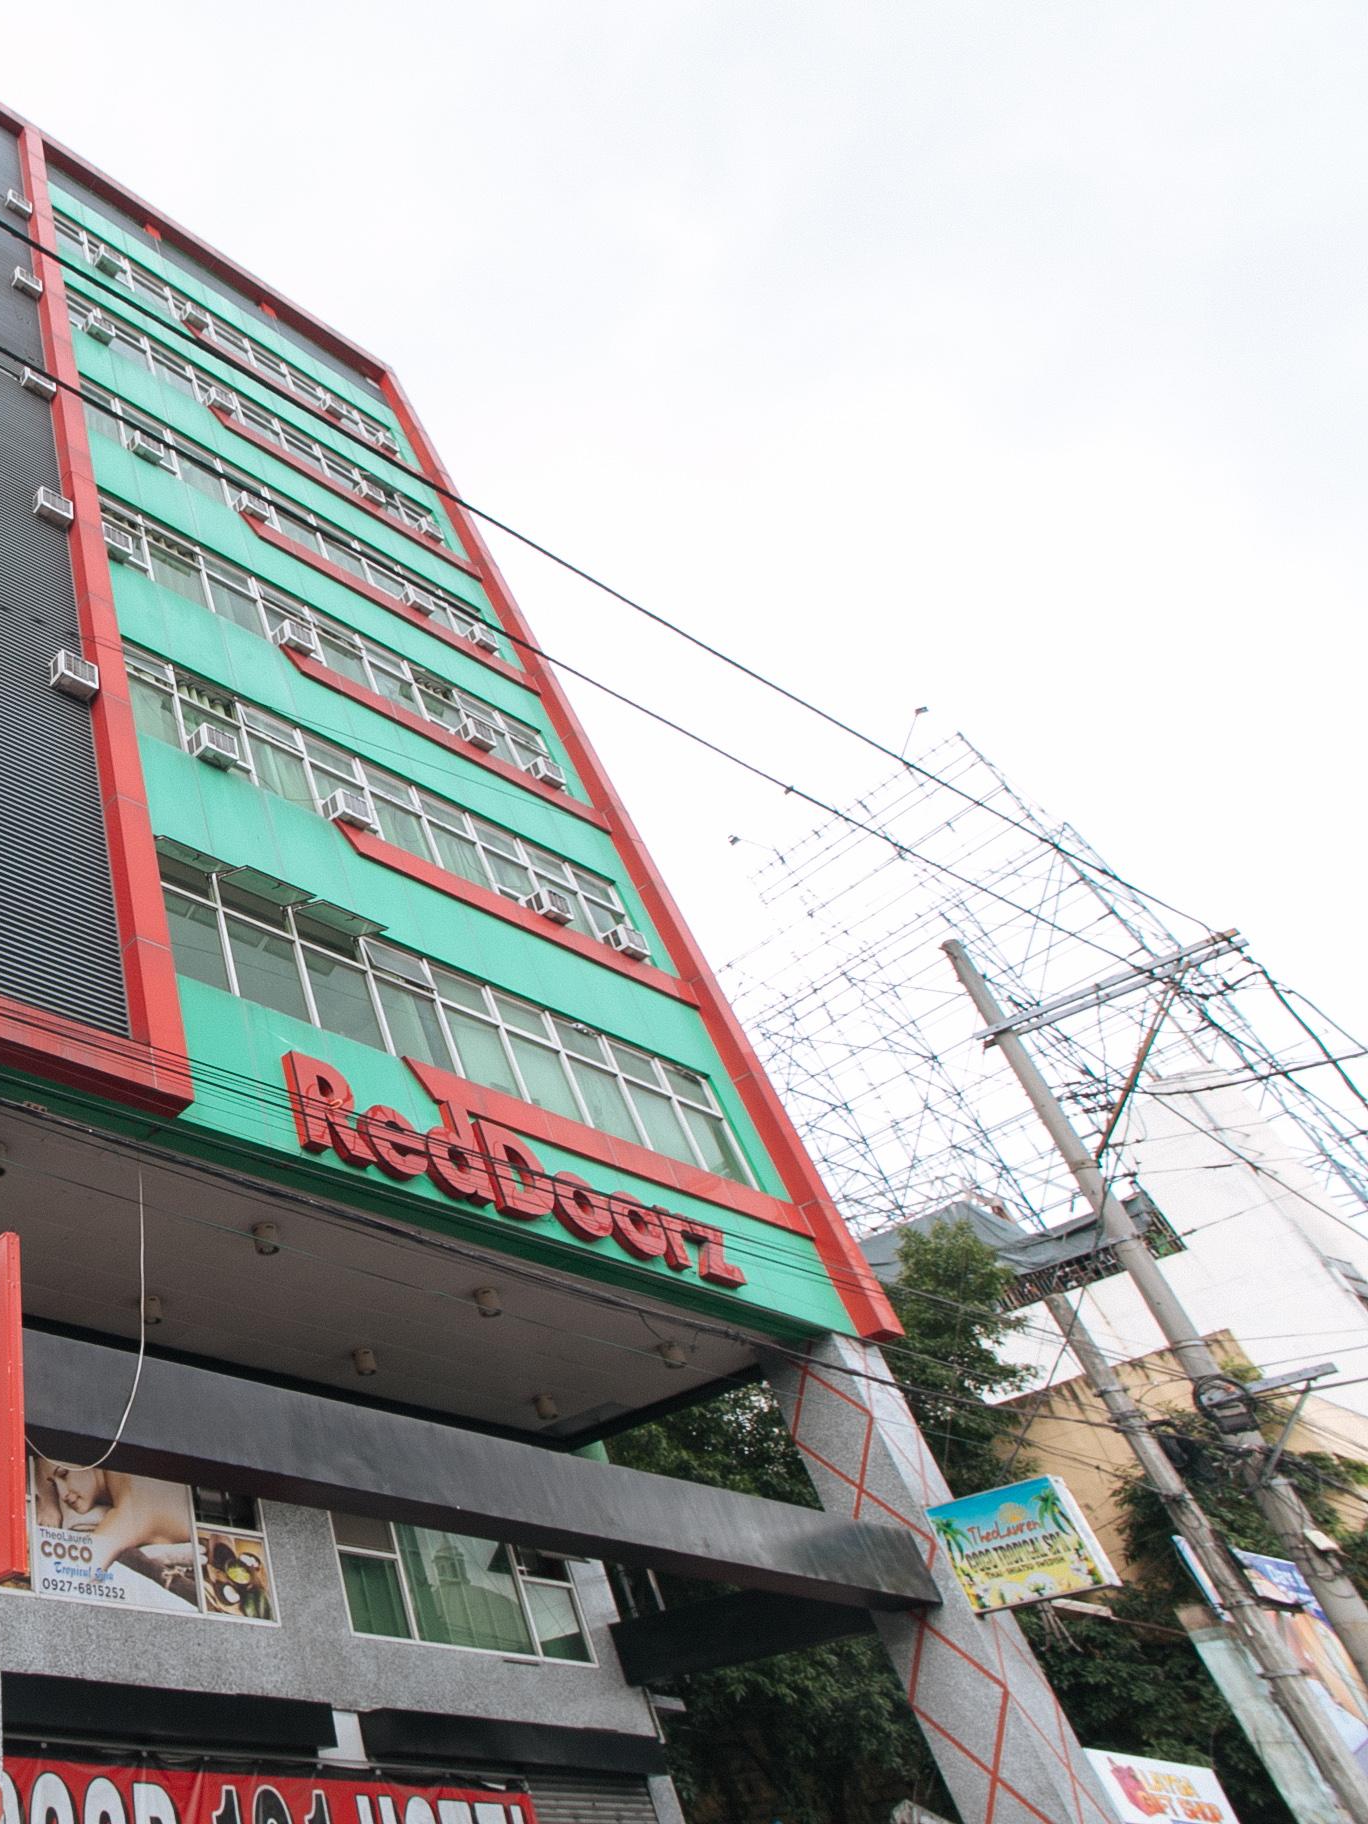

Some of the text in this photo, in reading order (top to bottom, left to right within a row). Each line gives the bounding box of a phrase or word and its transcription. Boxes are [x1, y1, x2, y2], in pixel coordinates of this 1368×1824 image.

[282, 1050, 747, 1289] RedDoorz
[40, 1527, 93, 1545] TheoLauren
[40, 1540, 93, 1563] COCO
[42, 1577, 126, 1600] 0927-6815252
